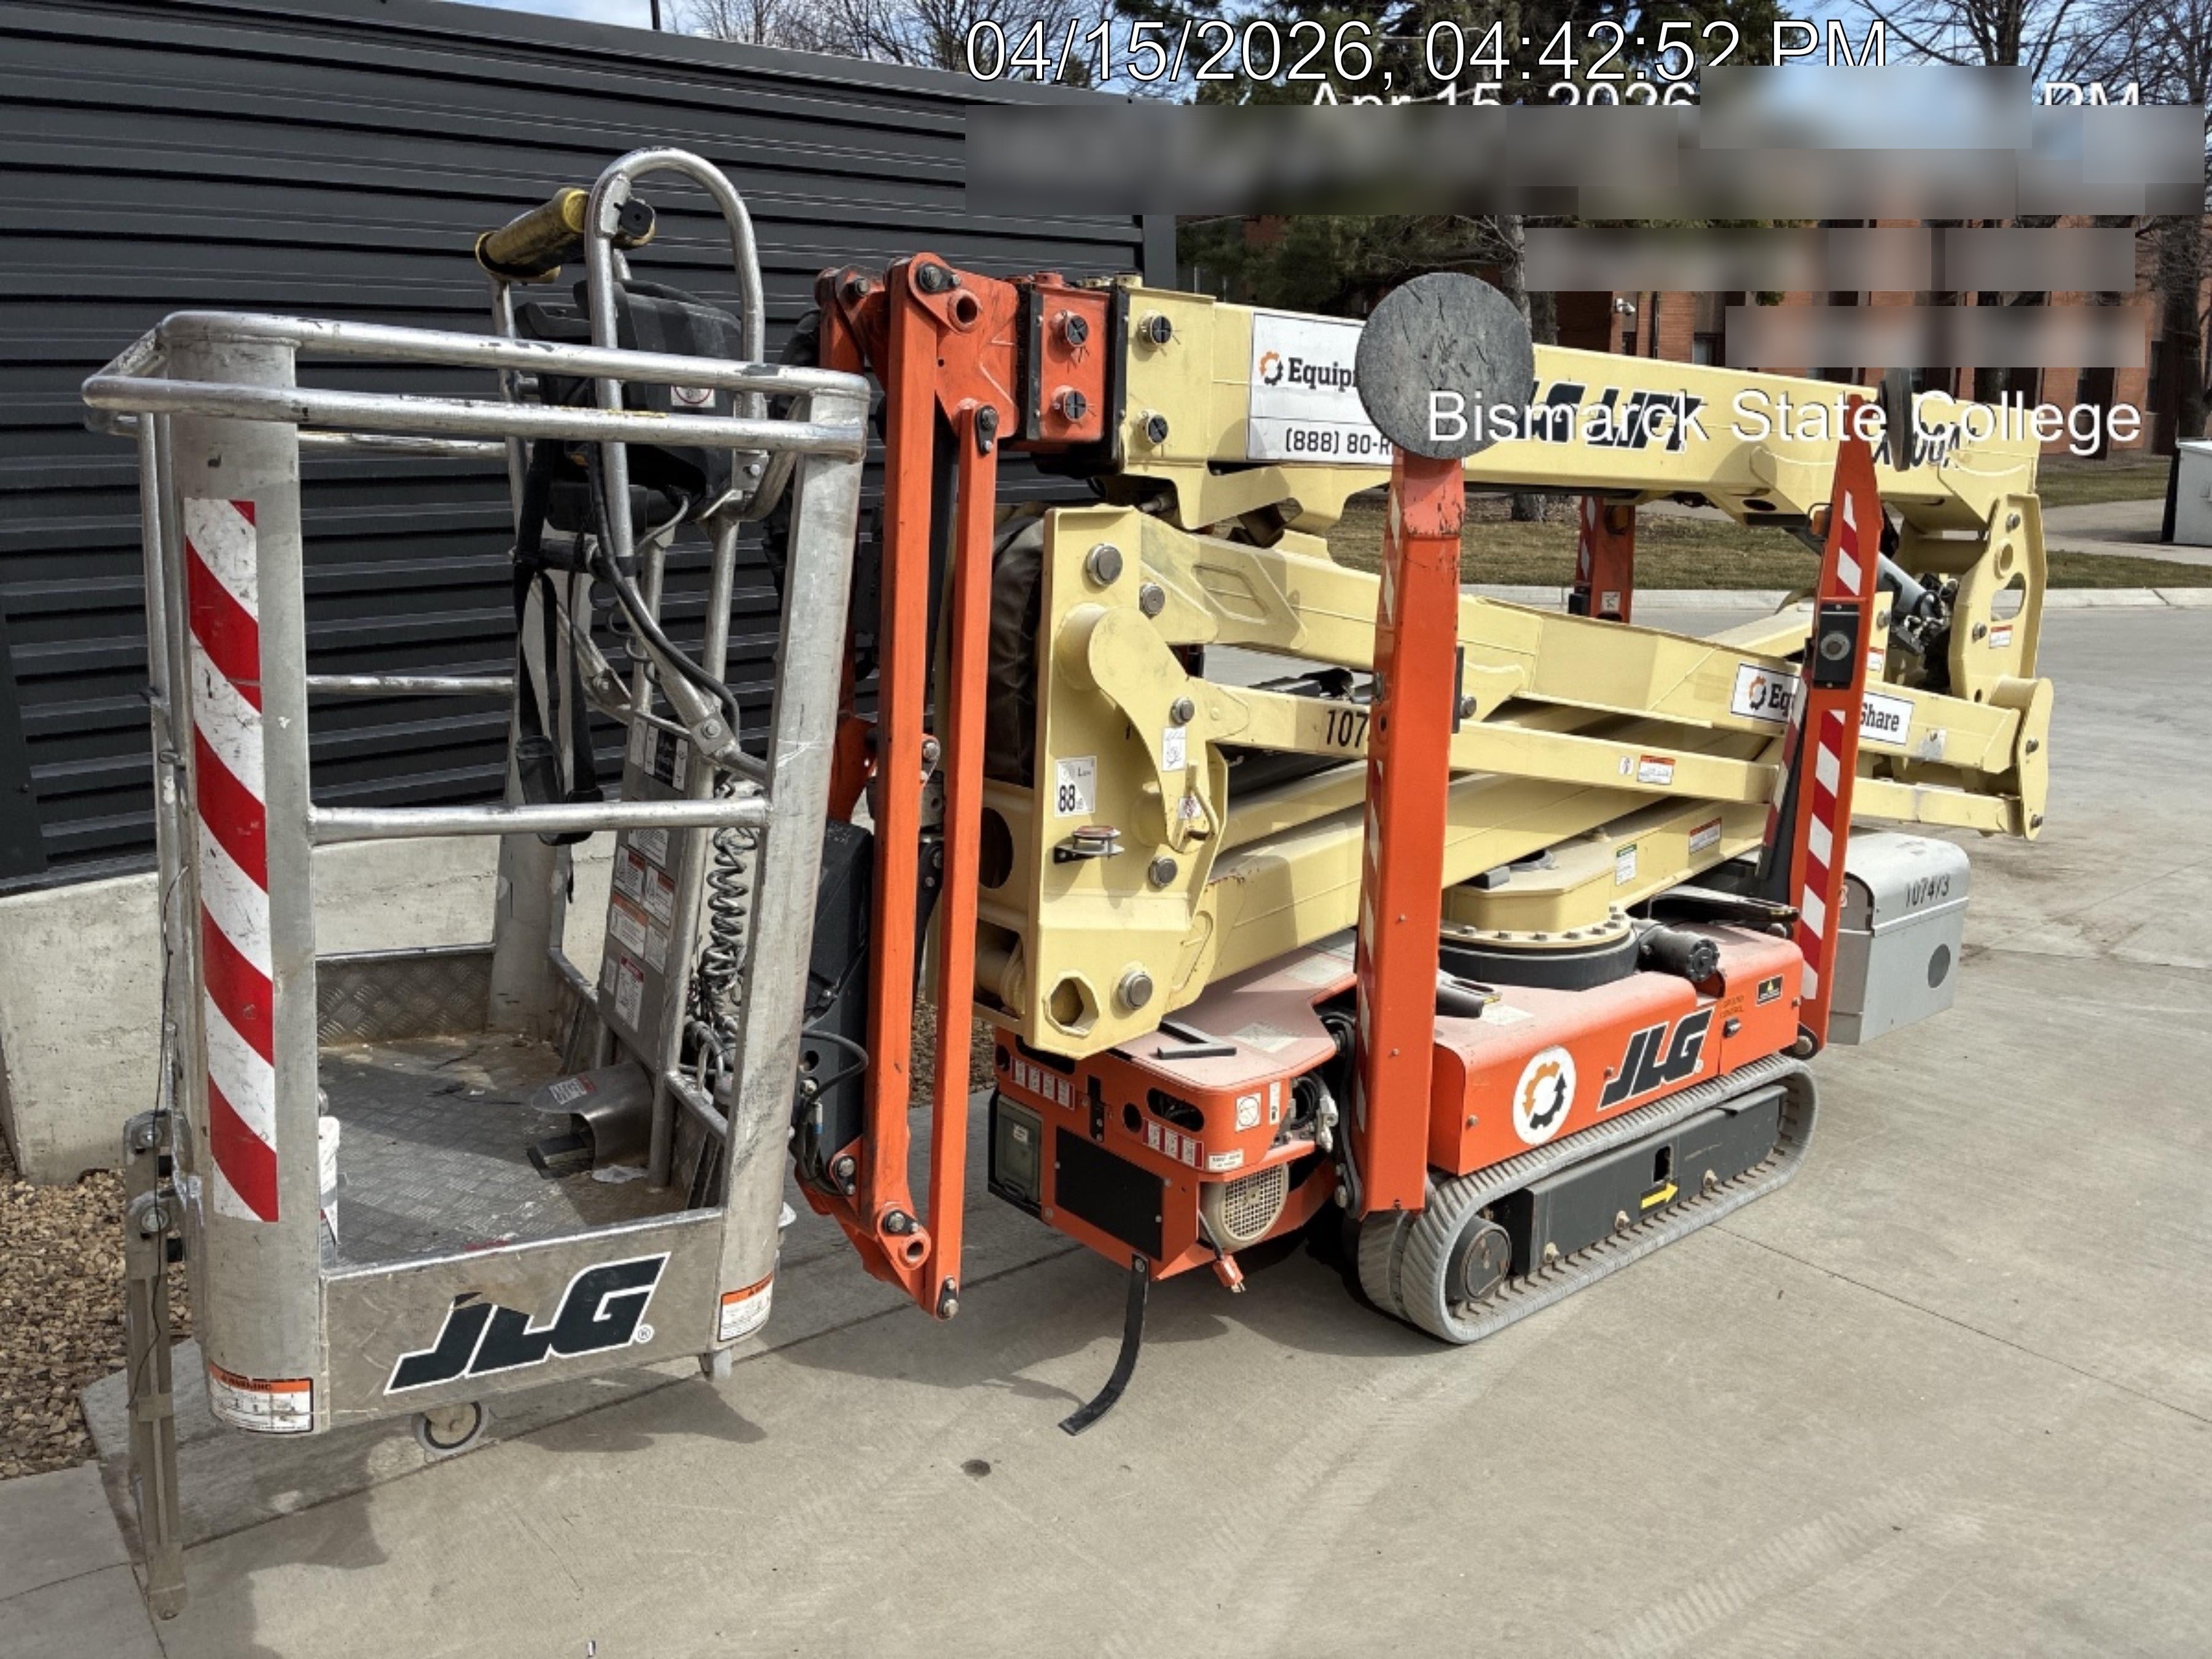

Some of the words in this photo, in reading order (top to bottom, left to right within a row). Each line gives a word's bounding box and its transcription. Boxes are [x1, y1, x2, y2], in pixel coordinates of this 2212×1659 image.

[1288, 356, 1357, 393] Equip
[1286, 428, 1339, 455] (888)
[1347, 433, 1392, 456] 80-R
[1327, 709, 1370, 748] 107
[1058, 784, 1075, 812] 88
[1597, 1005, 1716, 1112] JLG
[384, 1252, 670, 1395] JLG
